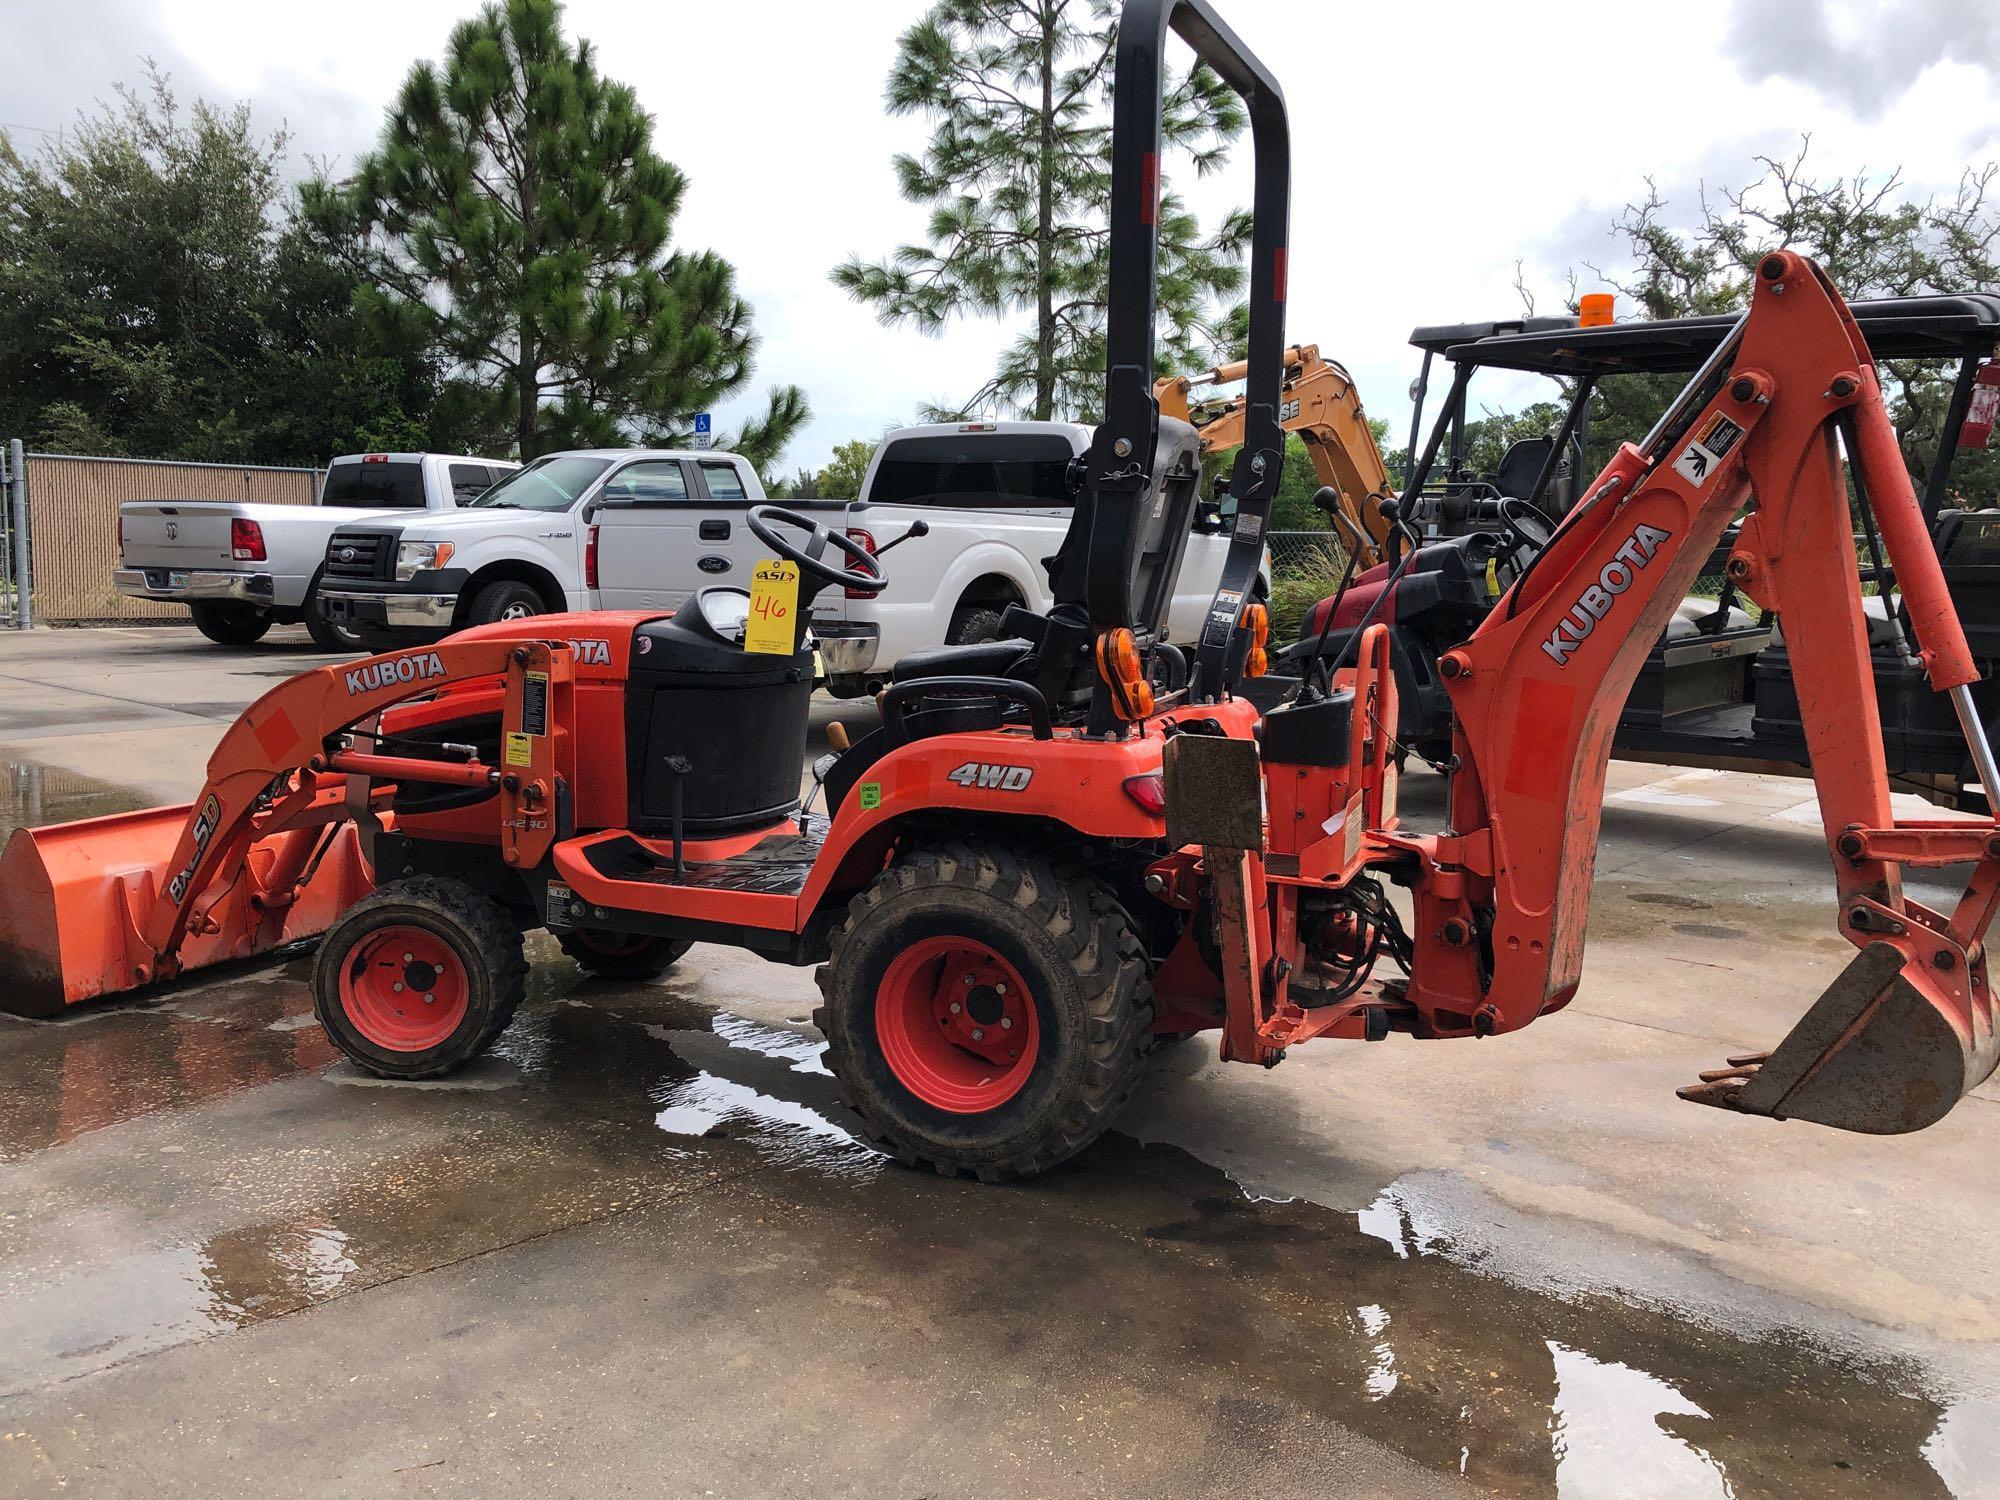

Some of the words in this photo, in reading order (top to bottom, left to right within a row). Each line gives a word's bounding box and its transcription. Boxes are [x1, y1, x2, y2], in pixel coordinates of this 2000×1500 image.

[754, 595, 787, 621] 46
[1541, 523, 1673, 665] KUBOTA
[344, 651, 447, 696] KUBOTA
[947, 762, 1034, 792] 4WD
